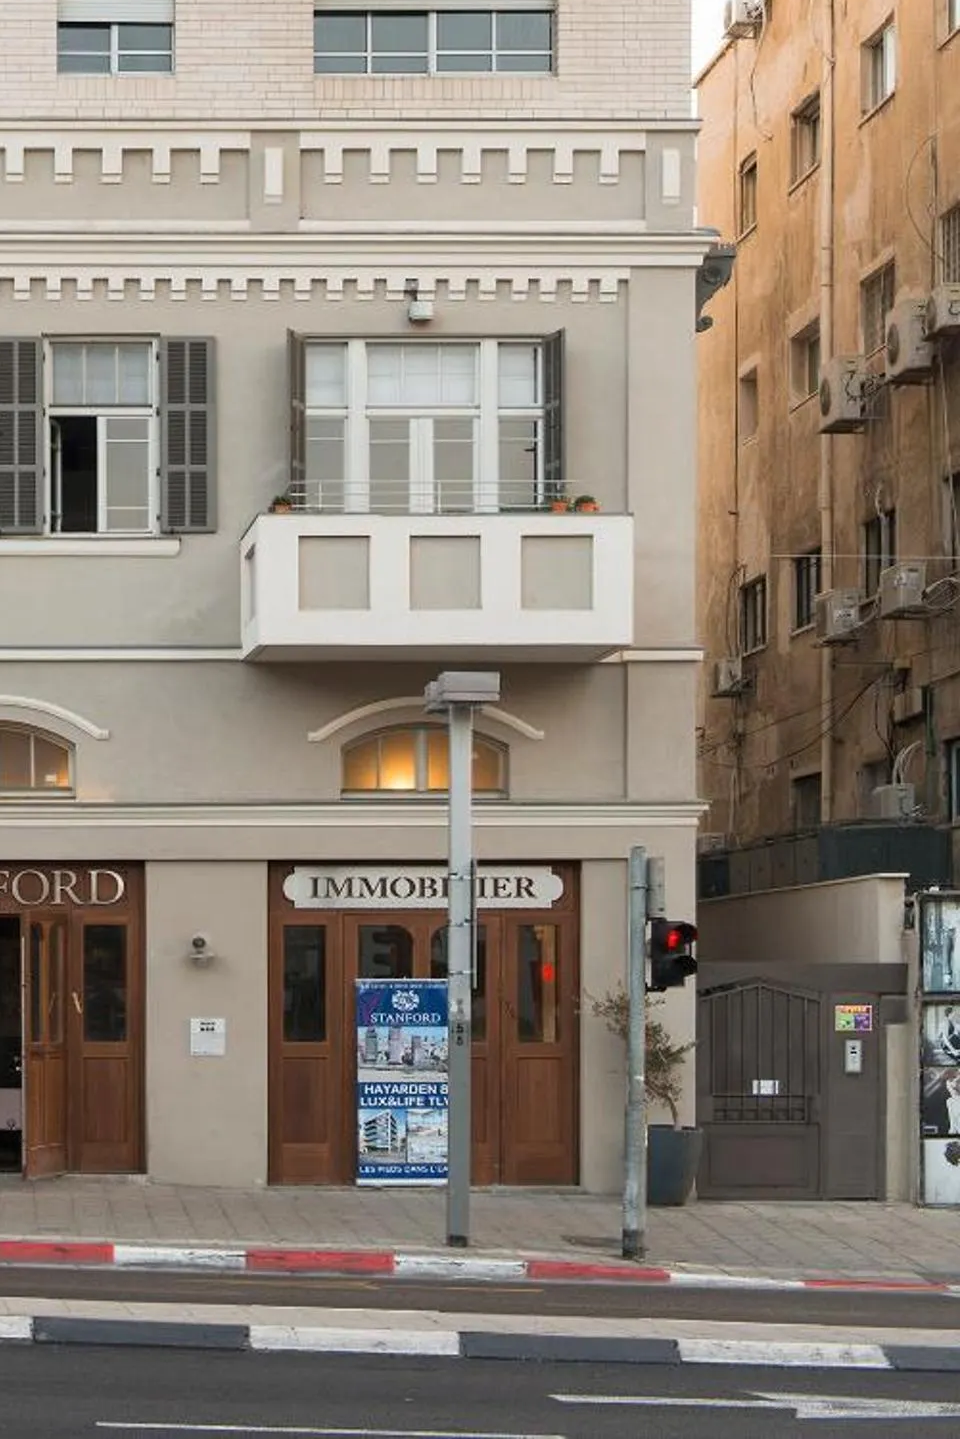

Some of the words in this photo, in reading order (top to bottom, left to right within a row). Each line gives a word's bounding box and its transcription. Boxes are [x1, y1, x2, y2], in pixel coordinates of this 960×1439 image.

[309, 876, 538, 899] IMMOBIIER
[370, 1012, 441, 1023] STANFORD
[364, 1084, 437, 1094] HAYARDEN
[361, 1097, 424, 1106] LUX&LIFE
